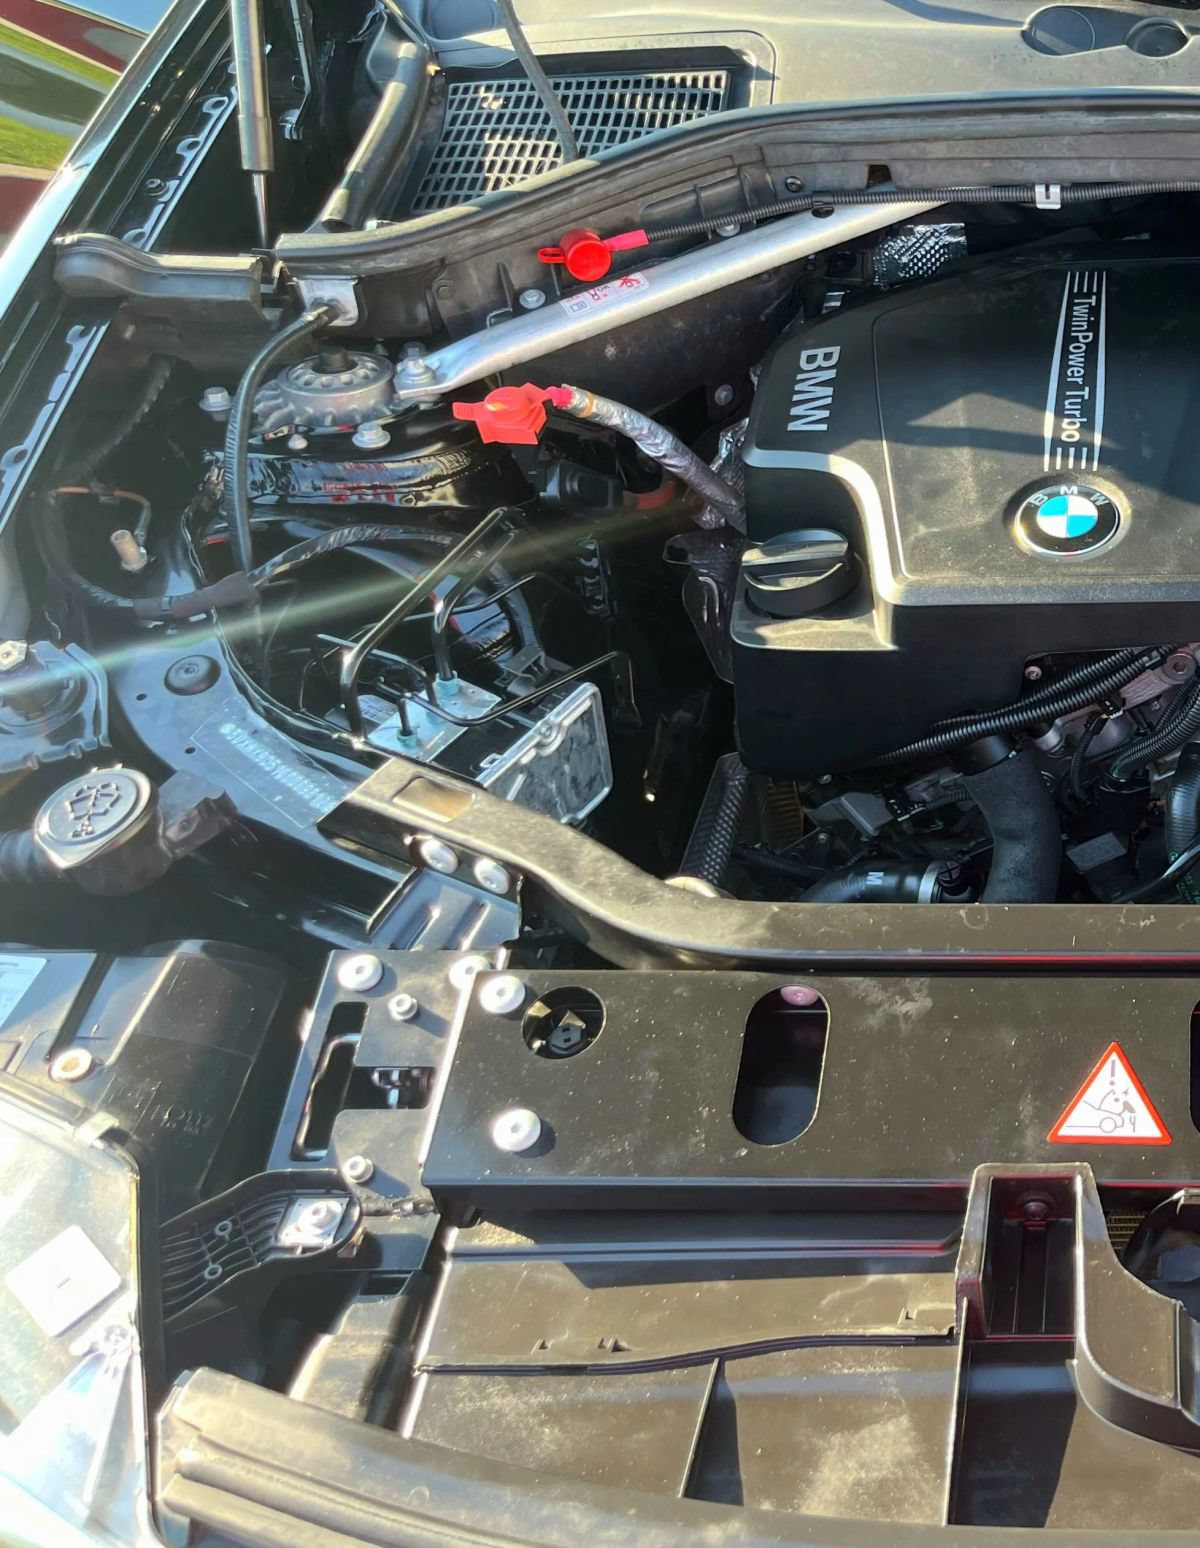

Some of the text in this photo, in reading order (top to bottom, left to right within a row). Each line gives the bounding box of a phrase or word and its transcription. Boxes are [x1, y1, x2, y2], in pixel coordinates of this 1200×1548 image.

[787, 345, 841, 431] BMW
[1061, 295, 1097, 442] TwinPower Turbo
[1028, 485, 1110, 506] BMW
